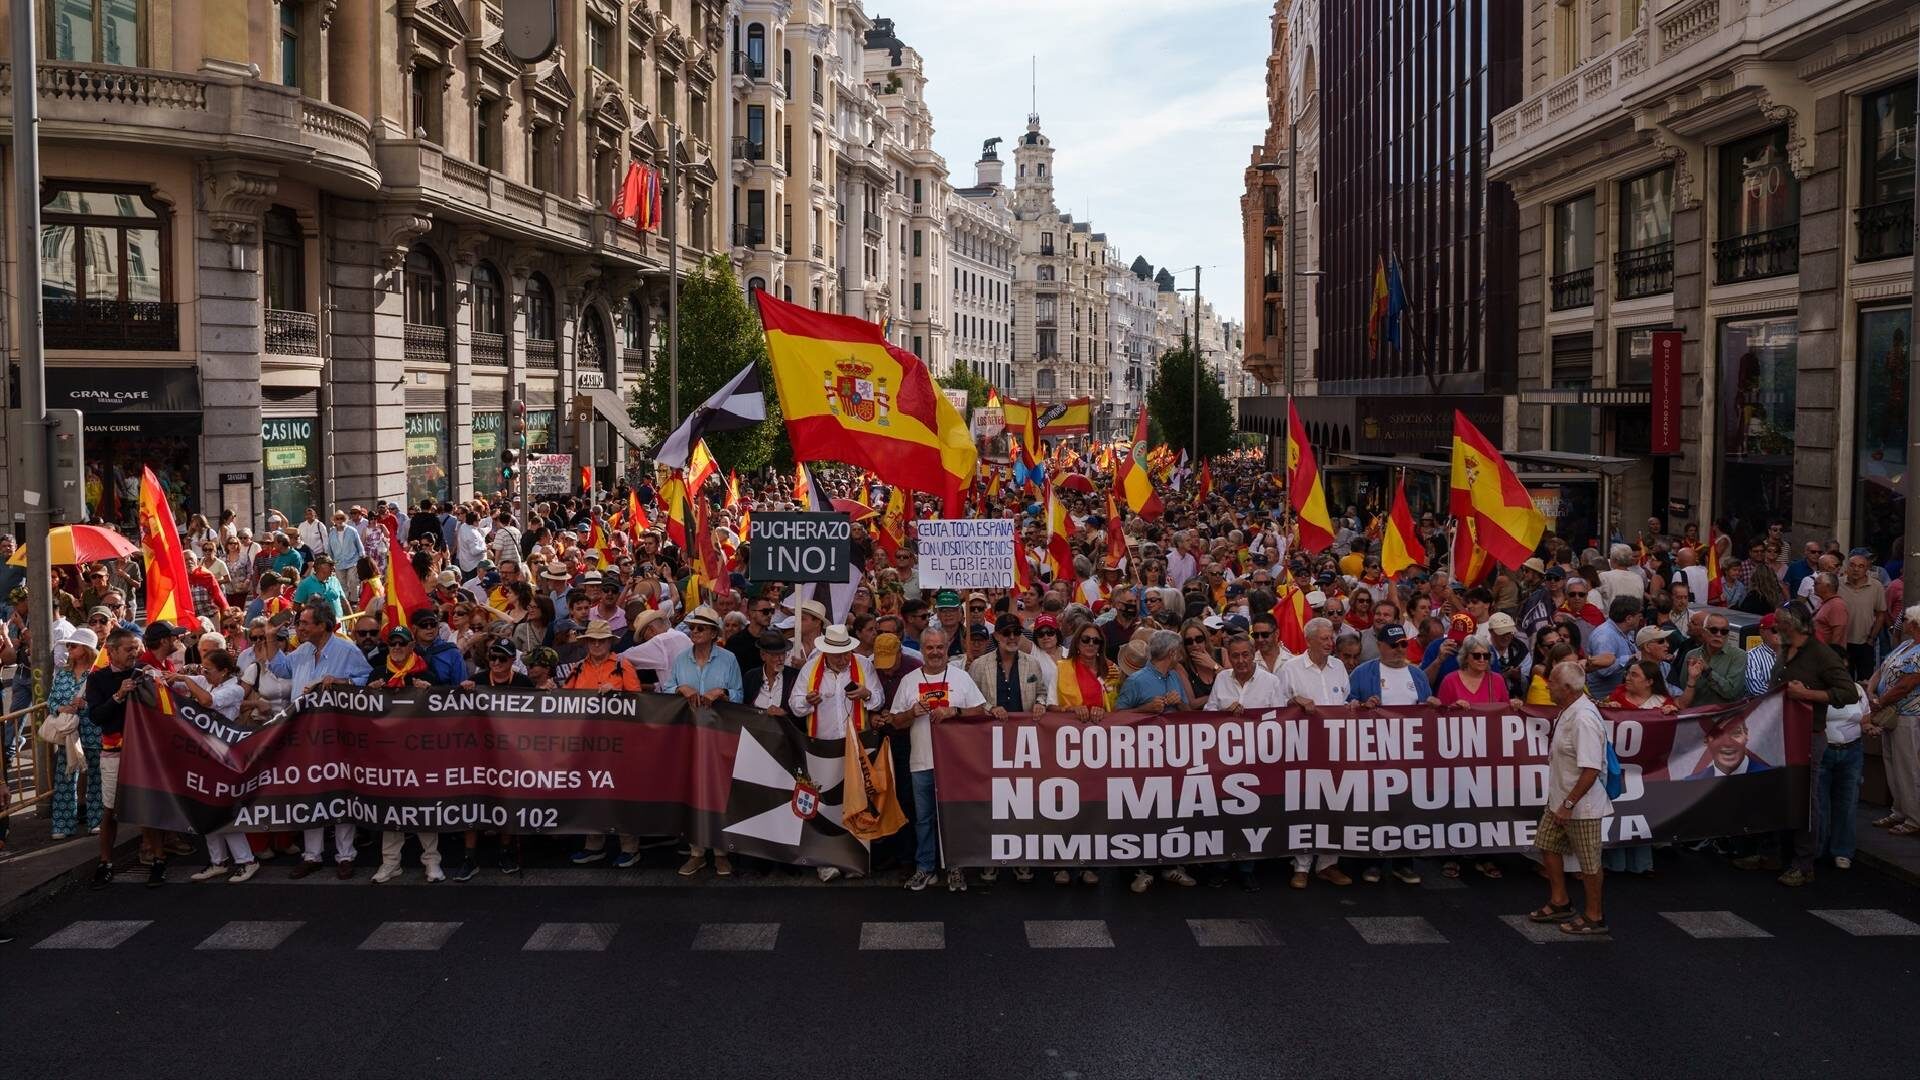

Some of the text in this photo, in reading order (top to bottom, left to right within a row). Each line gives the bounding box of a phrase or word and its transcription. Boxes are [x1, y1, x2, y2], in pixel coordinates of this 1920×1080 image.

[580, 374, 604, 388] CASINO
[70, 390, 149, 399] GRAN CAFÉ
[261, 422, 311, 441] CASINO
[750, 520, 850, 540] PUCHERAZO
[950, 521, 976, 538] TODA
[976, 520, 1014, 538] ESPAÑA
[983, 540, 1014, 556] MENOS
[767, 545, 836, 574] ¡NO!
[931, 556, 1012, 571] EL GOBIERNO
[945, 571, 1012, 588] MARCIANO
[428, 689, 535, 713] SÁNCHEZ
[542, 694, 637, 717] DIMISIÓN
[404, 729, 477, 750] CEUTA
[484, 733, 509, 751] SE
[524, 736, 624, 753] DEFIENDE
[992, 725, 1041, 769] LA
[1055, 711, 1309, 769] CORRUPCIÓN
[1324, 717, 1424, 762] TIENE
[1438, 715, 1488, 761] UN
[186, 770, 210, 795] EL
[215, 765, 300, 798] PUEBLO
[307, 762, 351, 783] CON
[354, 766, 420, 788] CEUTA
[445, 766, 582, 790] ELECCIONES
[587, 770, 616, 790] YA
[992, 763, 1645, 821] NO MÁS IMPUNIDD
[233, 796, 559, 829] APLICACIÓN ARTÍCULO 102
[991, 814, 1653, 861] DIMISIÓN Y ELECCIONE YA
